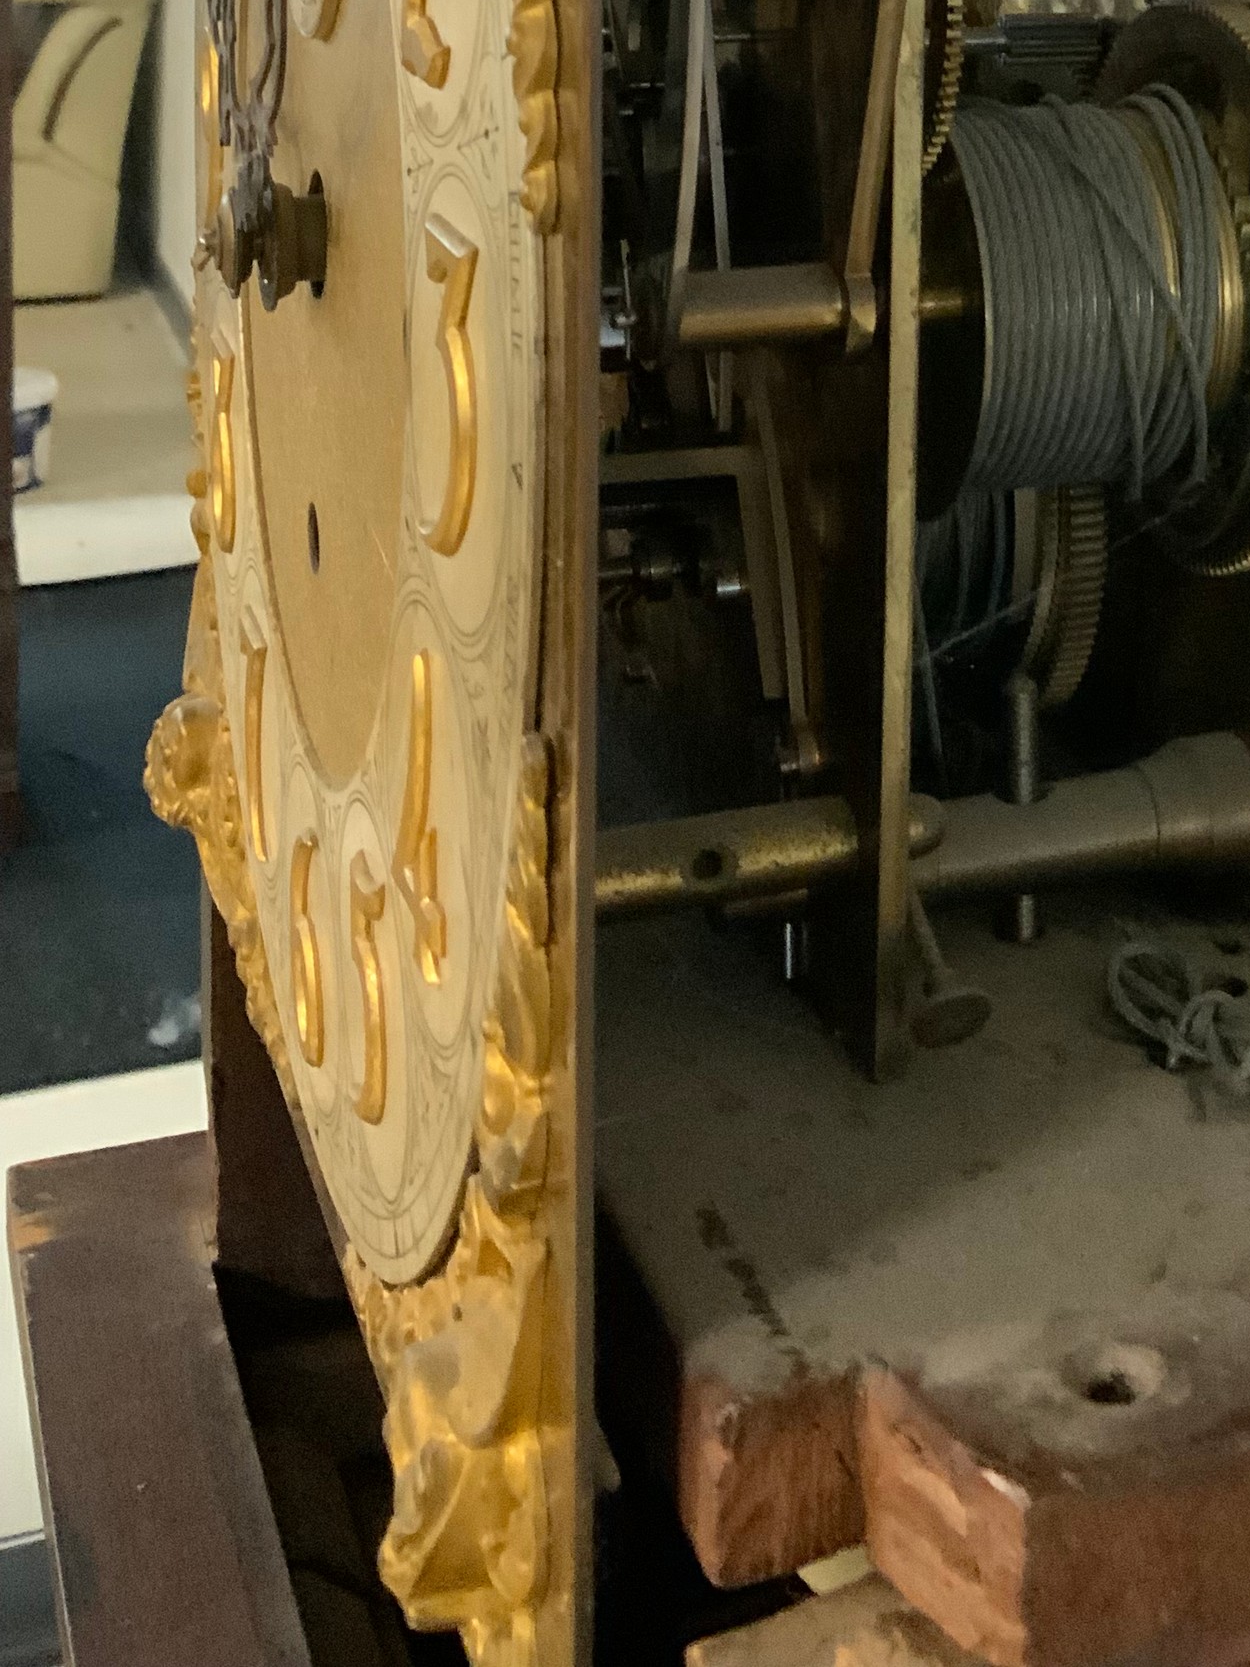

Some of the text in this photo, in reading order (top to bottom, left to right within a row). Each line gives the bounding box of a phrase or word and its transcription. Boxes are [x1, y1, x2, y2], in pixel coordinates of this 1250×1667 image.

[417, 212, 479, 557] 3
[240, 605, 267, 862] 7
[391, 648, 447, 984] 4
[291, 828, 323, 1068] 6
[350, 849, 386, 1125] 5
